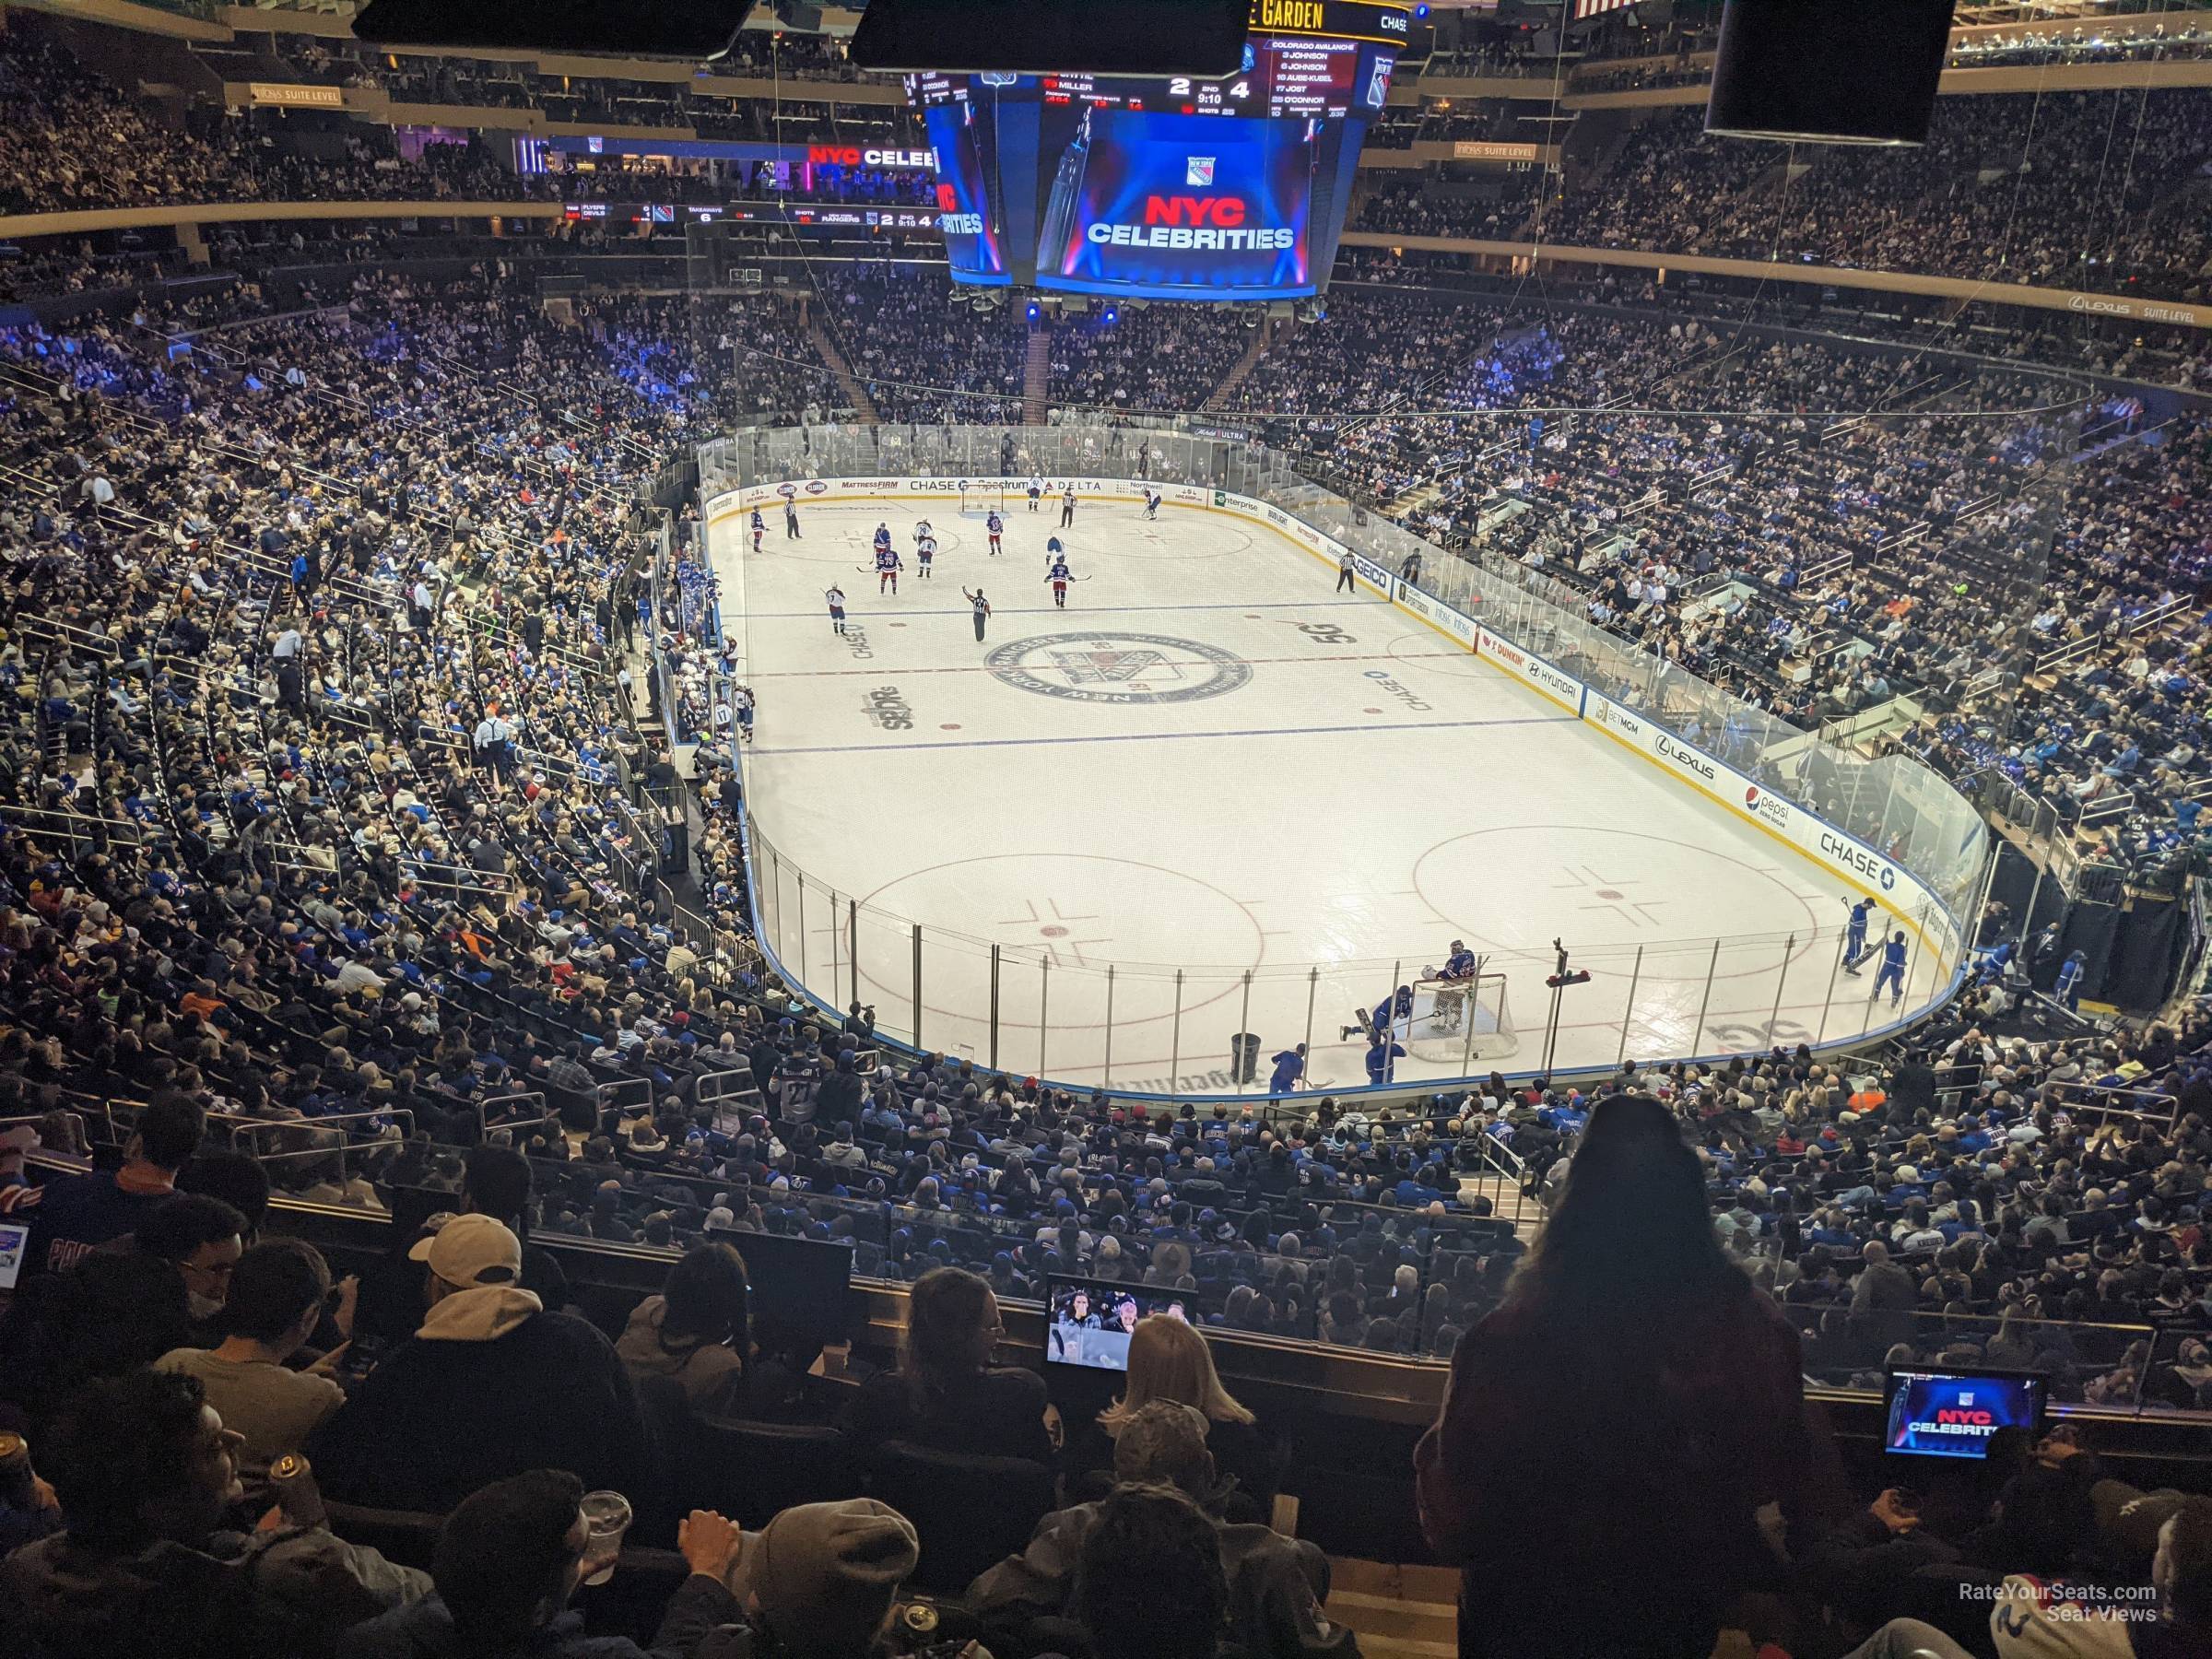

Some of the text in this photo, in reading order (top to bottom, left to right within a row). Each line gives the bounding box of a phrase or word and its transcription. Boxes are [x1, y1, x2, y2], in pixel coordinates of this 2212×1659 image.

[1262, 0, 1323, 29] GARDEN
[1381, 16, 1406, 32] CHASE
[1272, 41, 1313, 50] COLORADO
[1288, 52, 1327, 60] JOHNSON
[1287, 74, 1333, 82] AUBE-KUBEL
[1058, 82, 1093, 91] MILLER
[1170, 78, 1250, 98] 2 4
[285, 89, 310, 100] SUITE
[312, 91, 338, 101] LEVEL
[1197, 94, 1221, 104] 9:10
[808, 147, 860, 164] NYC
[1484, 147, 1507, 156] SUITE
[1509, 147, 1534, 157] LEVEL
[700, 214, 711, 222] 6
[1146, 196, 1244, 226] NYC
[881, 215, 894, 226] 2
[898, 219, 916, 228] 9:10
[918, 216, 931, 227] 4
[1088, 223, 1293, 250] CELEBRITIES
[2085, 301, 2194, 324] LEXUS SUITE LEVEL
[715, 438, 735, 447] ULRA
[1221, 430, 1244, 440] ULTRA
[910, 479, 1101, 491] CHASE Spectrum DELTA
[1130, 482, 1163, 490] Northwell
[1218, 495, 1258, 512] enterprise
[1277, 514, 1288, 525] LIGHT
[1357, 559, 1387, 589] GEICO
[1497, 644, 1525, 667] DUNKIN'
[994, 635, 1131, 702] NEW YORK RANGERS
[1541, 669, 1576, 698] HYUNDAI
[1375, 679, 1432, 710] CHASE
[717, 710, 727, 722] 17
[1608, 710, 1639, 735] BETMGM
[1671, 746, 1714, 780] LEXUS
[1760, 796, 1789, 820] pepsi
[1759, 809, 1786, 829] ZERO SUGAR
[1820, 832, 1879, 880] CHASE
[788, 1082, 810, 1105] 27
[1937, 1409, 1992, 1425] NYC
[1908, 1421, 1997, 1436] CELEBRIT
